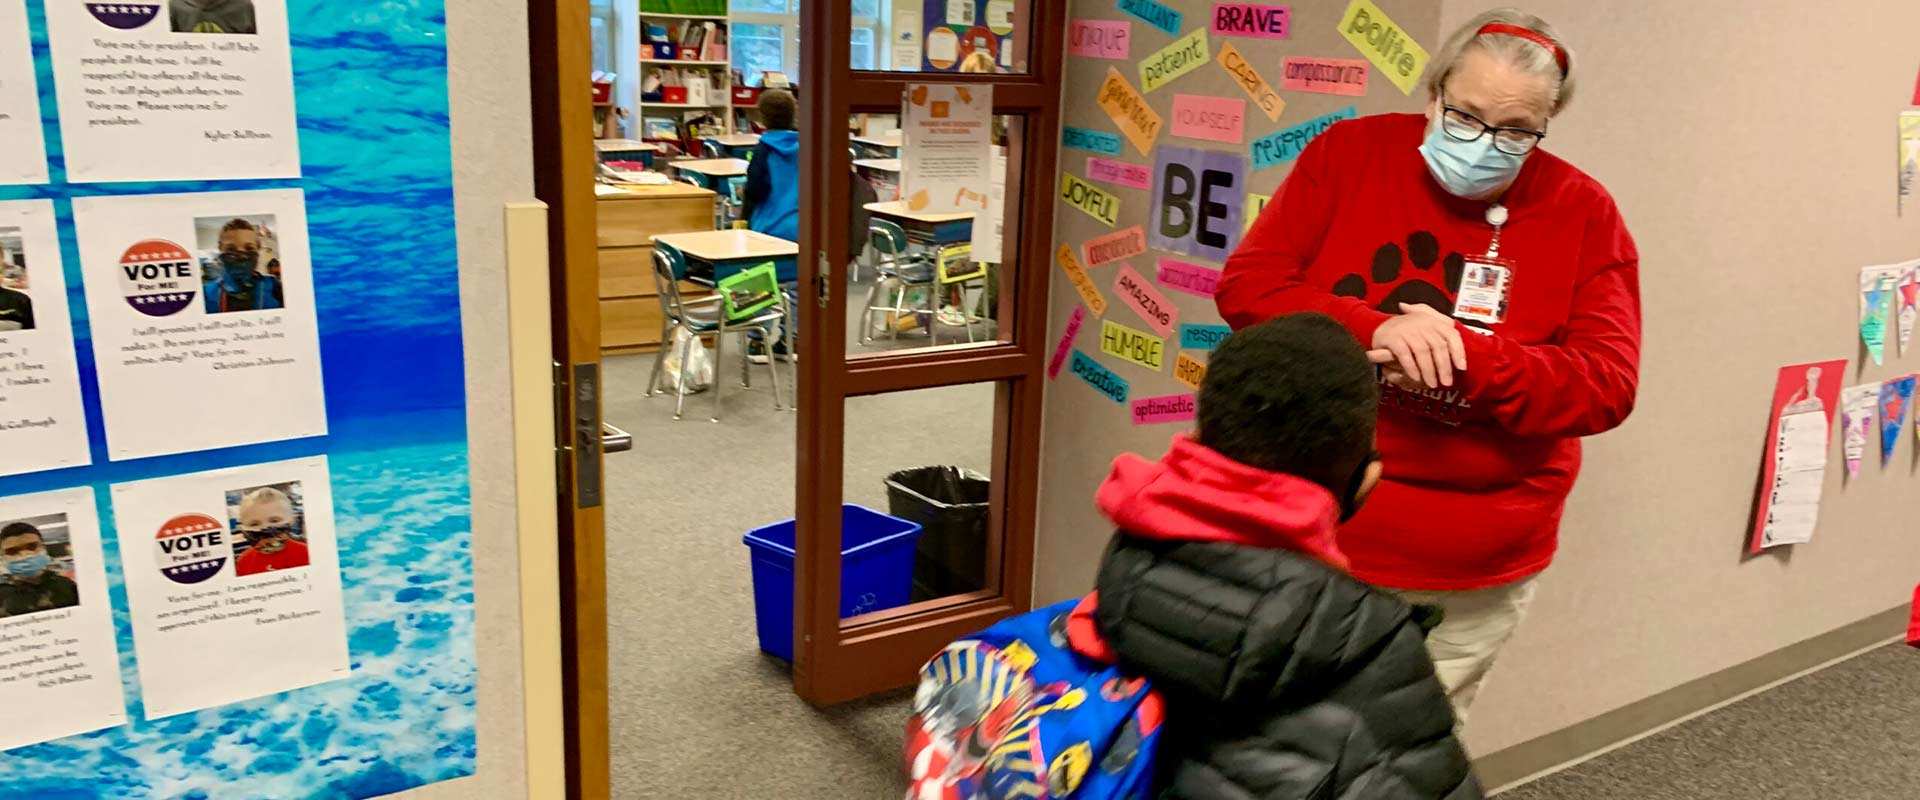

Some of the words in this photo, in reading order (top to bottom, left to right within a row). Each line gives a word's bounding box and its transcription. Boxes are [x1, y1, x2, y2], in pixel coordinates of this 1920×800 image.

[1216, 7, 1285, 34] BRAVE
[94, 39, 118, 49] Vote
[218, 42, 235, 51] will
[1348, 8, 1417, 78] polite
[81, 55, 117, 65] people
[120, 55, 133, 64] all
[135, 55, 152, 65] the
[191, 56, 208, 65] will
[210, 57, 223, 66] be
[1145, 36, 1205, 83] patient
[187, 71, 199, 80] all
[202, 71, 219, 81] the
[1225, 51, 1276, 112] CARING
[117, 86, 136, 95] will
[137, 86, 160, 97] play
[161, 86, 184, 95] with
[87, 101, 112, 110] Vote
[137, 101, 171, 110] Please
[1177, 108, 1241, 131] YOURSELF
[1063, 178, 1114, 223] JOYFUL
[1160, 162, 1233, 250] BE
[124, 262, 192, 281] VOTE
[138, 282, 156, 291] For
[159, 281, 178, 289] ME!
[1119, 275, 1171, 326] AMAZING
[191, 350, 215, 359] Vote
[1104, 333, 1162, 368] HUMBLE
[1073, 358, 1125, 404] creative
[1135, 397, 1194, 421] optimistic
[160, 531, 223, 554] VOTE
[172, 554, 189, 563] For
[192, 550, 211, 559] ME!
